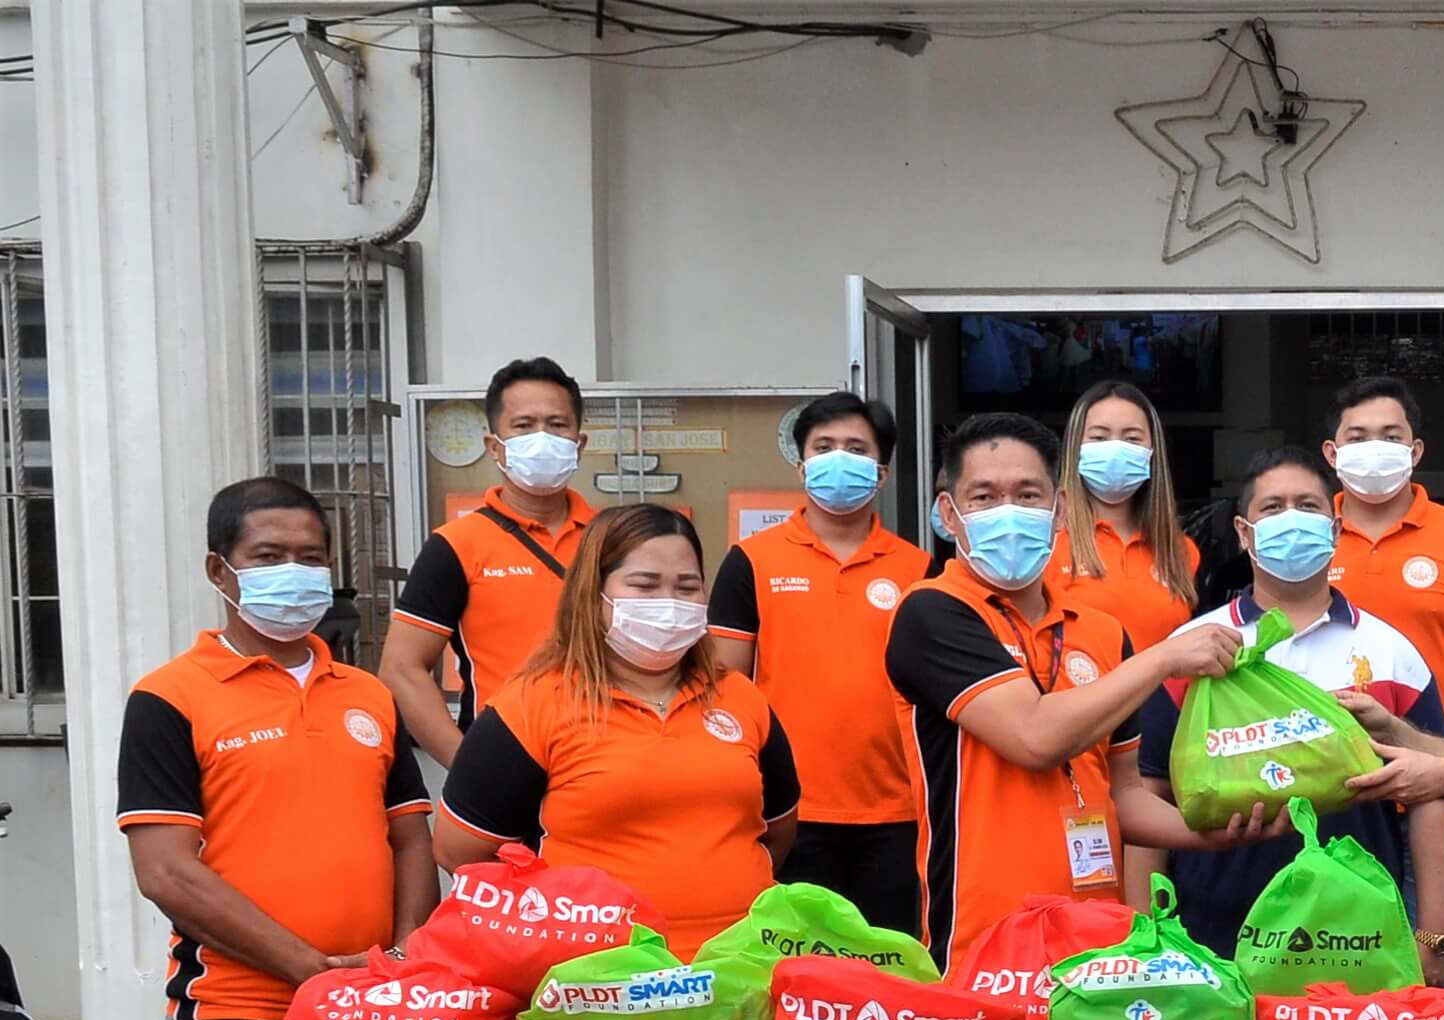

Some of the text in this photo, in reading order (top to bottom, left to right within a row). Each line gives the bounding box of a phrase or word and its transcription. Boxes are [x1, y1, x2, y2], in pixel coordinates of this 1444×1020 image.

[680, 431, 720, 446] JOSE
[249, 727, 288, 744] JOEL
[1221, 723, 1268, 746] PLDT
[553, 896, 637, 926] Smart
[1238, 926, 1384, 951] PLDT Smart
[1086, 959, 1139, 977] PLDT
[1252, 955, 1364, 968] FOUNDATION
[405, 985, 493, 1011] Smart
[563, 974, 712, 1004] PLDT SMART
[568, 994, 711, 1012] FOUNDATION
